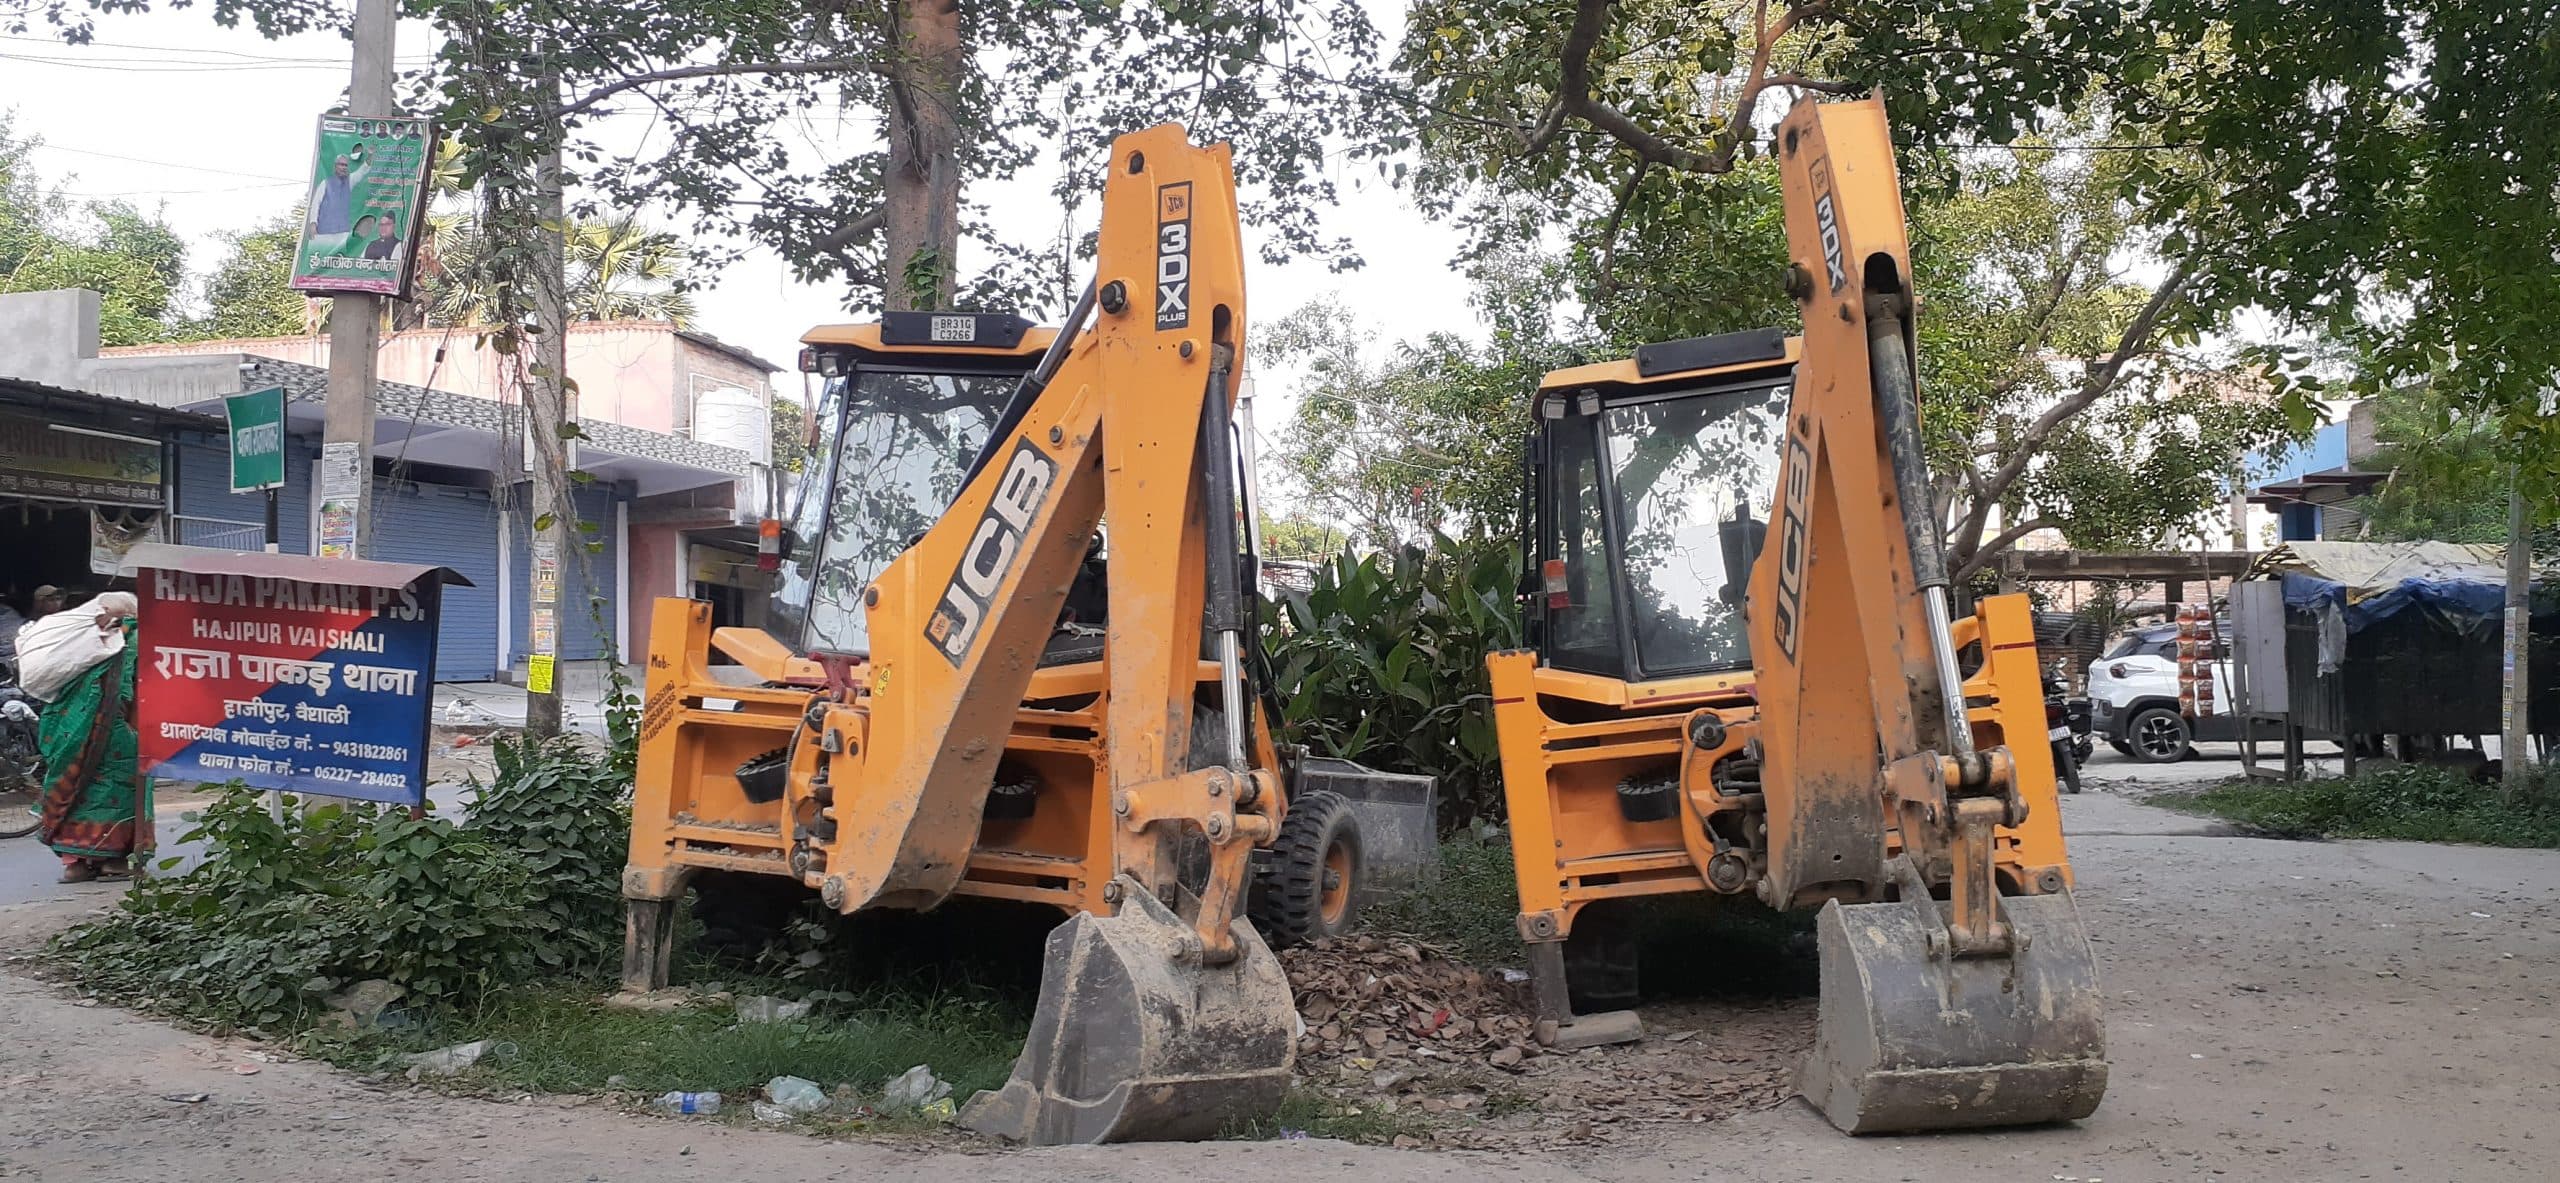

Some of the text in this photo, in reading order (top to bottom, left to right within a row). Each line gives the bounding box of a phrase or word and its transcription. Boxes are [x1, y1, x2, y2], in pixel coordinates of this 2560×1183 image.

[1166, 194, 1185, 214] JCB
[1817, 195, 1846, 289] 3DX
[1157, 223, 1188, 313] 3DX
[940, 319, 971, 329] BR31G
[940, 330, 971, 340] C3266
[1157, 312, 1187, 324] PLUS
[945, 448, 1051, 656] JCB
[1781, 445, 1808, 654] JCB
[154, 570, 425, 621] RAJA PAKAR P.S.
[193, 618, 385, 654] HAJIPUR VAISHALI
[153, 646, 418, 697] राजा पाकड़ थाना
[295, 702, 352, 725] वैशाली
[198, 751, 235, 770] थाना
[237, 753, 273, 775] फोन
[232, 727, 292, 751] मोबाईल
[332, 741, 409, 763] 9431822861
